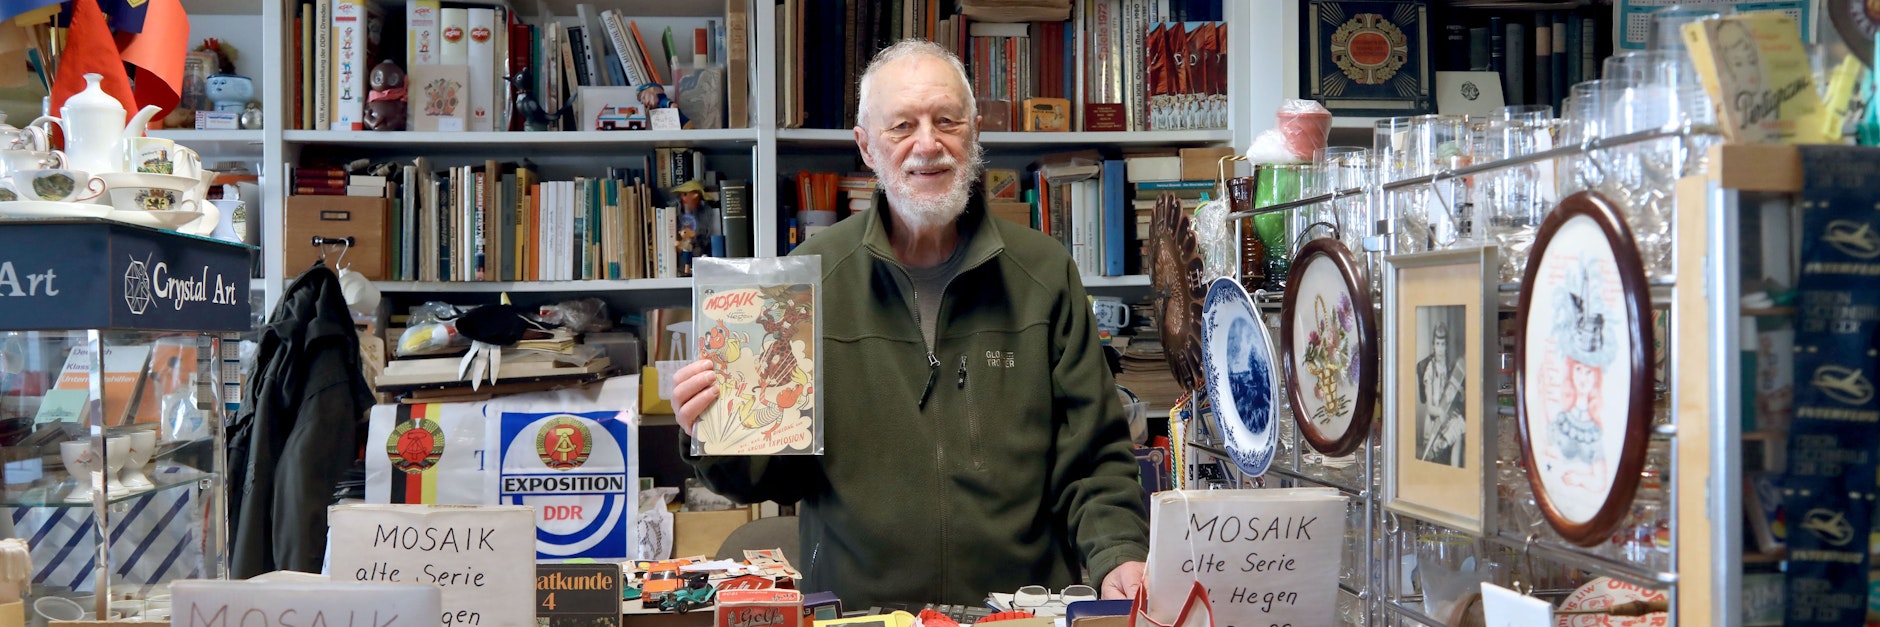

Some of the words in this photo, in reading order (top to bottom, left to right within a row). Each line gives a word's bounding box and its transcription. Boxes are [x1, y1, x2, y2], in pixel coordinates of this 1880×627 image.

[1097, 3, 1109, 25] 1972
[611, 31, 630, 64] MELBOURNE
[1097, 27, 1110, 61] Spiele
[319, 59, 327, 111] Kunstausstellung
[0, 261, 59, 297] Art
[153, 262, 208, 310] Crystal
[212, 274, 237, 305] Art
[705, 291, 758, 311] MOSAIK
[768, 432, 805, 447] EXPLOSION
[504, 475, 624, 493] EXPOSITION
[543, 505, 583, 521] DDR
[373, 523, 496, 553] MOSAIK
[1184, 513, 1318, 543] MOSAIK
[1181, 553, 1226, 574] alte
[1240, 552, 1297, 573] Serie
[355, 562, 401, 583] alte
[415, 564, 486, 587] Serie
[536, 571, 613, 590] atkunde
[542, 592, 557, 611] 4
[1229, 586, 1298, 613] Hegen
[441, 611, 480, 627] gen
[741, 607, 779, 627] Golf
